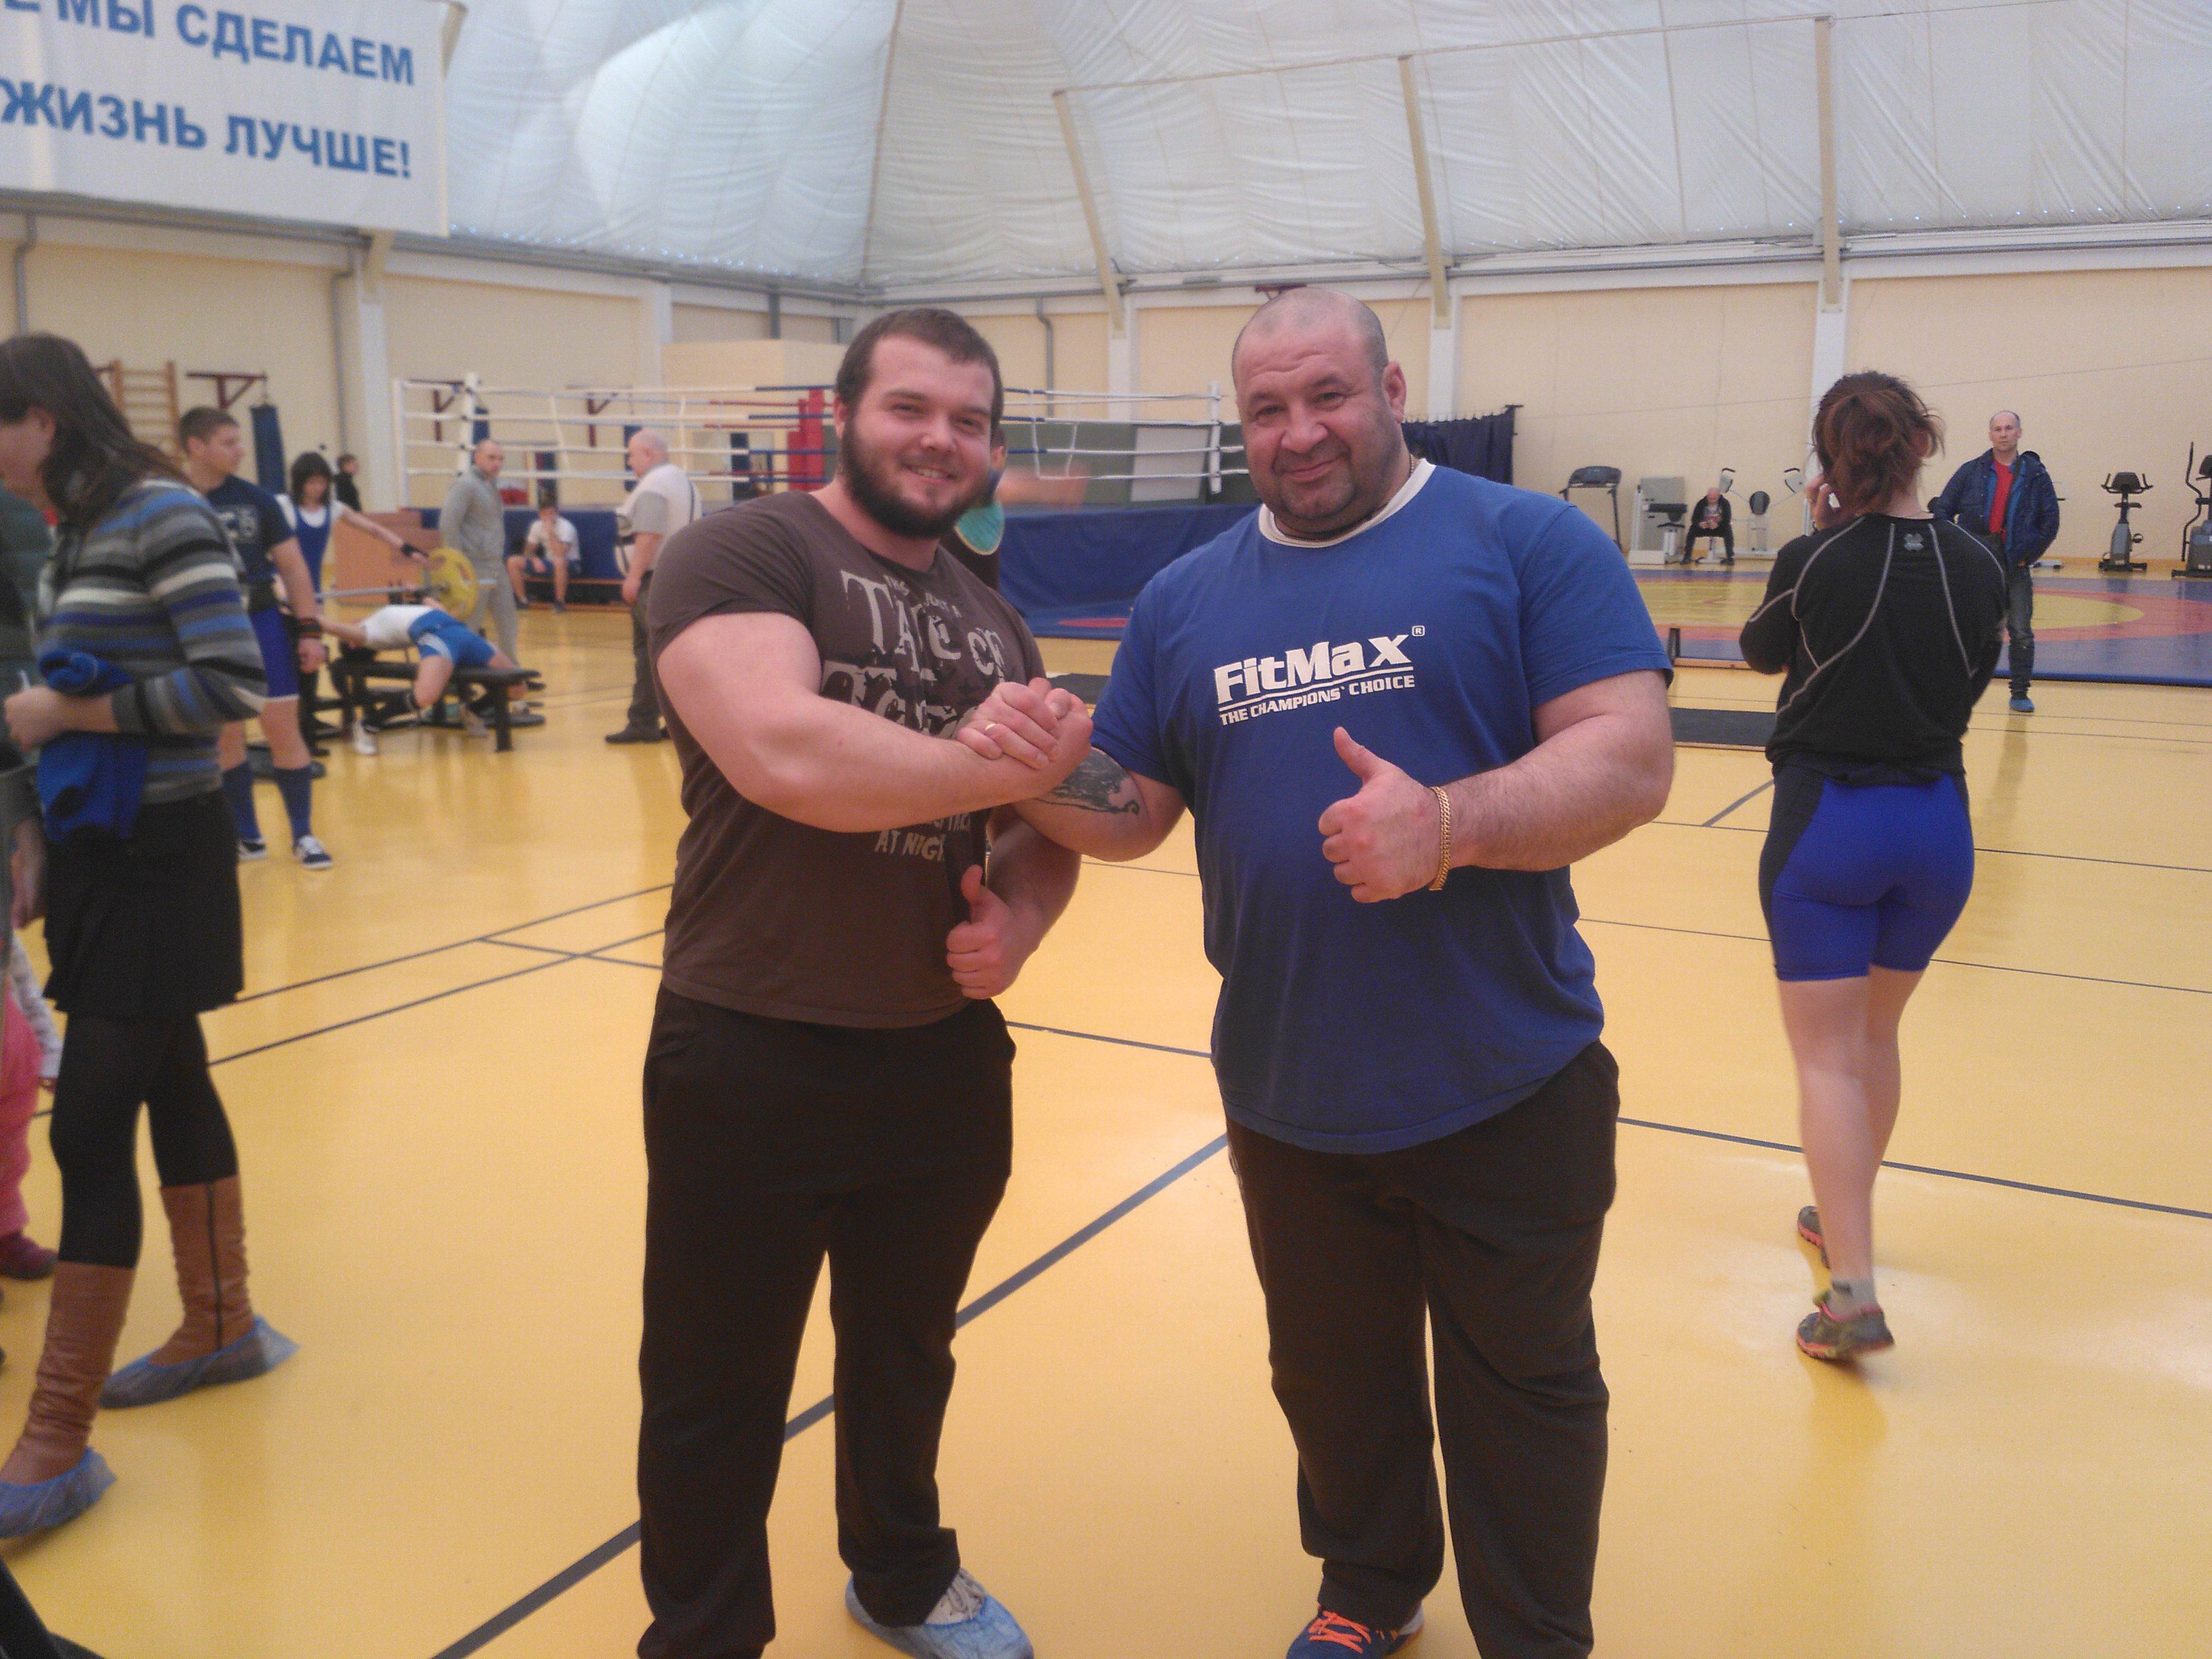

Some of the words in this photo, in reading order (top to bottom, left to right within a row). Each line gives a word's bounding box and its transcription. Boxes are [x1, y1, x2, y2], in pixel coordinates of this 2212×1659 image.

[57, 0, 155, 38] МЫ
[176, 3, 415, 86] СДЕЛАЕМ
[0, 78, 207, 150] ЖИЗНЬ
[225, 113, 412, 179] ЛУЧШЕ!
[1220, 710, 1249, 726] THE
[1349, 675, 1415, 696] CHOICE
[874, 830, 901, 854] AT
